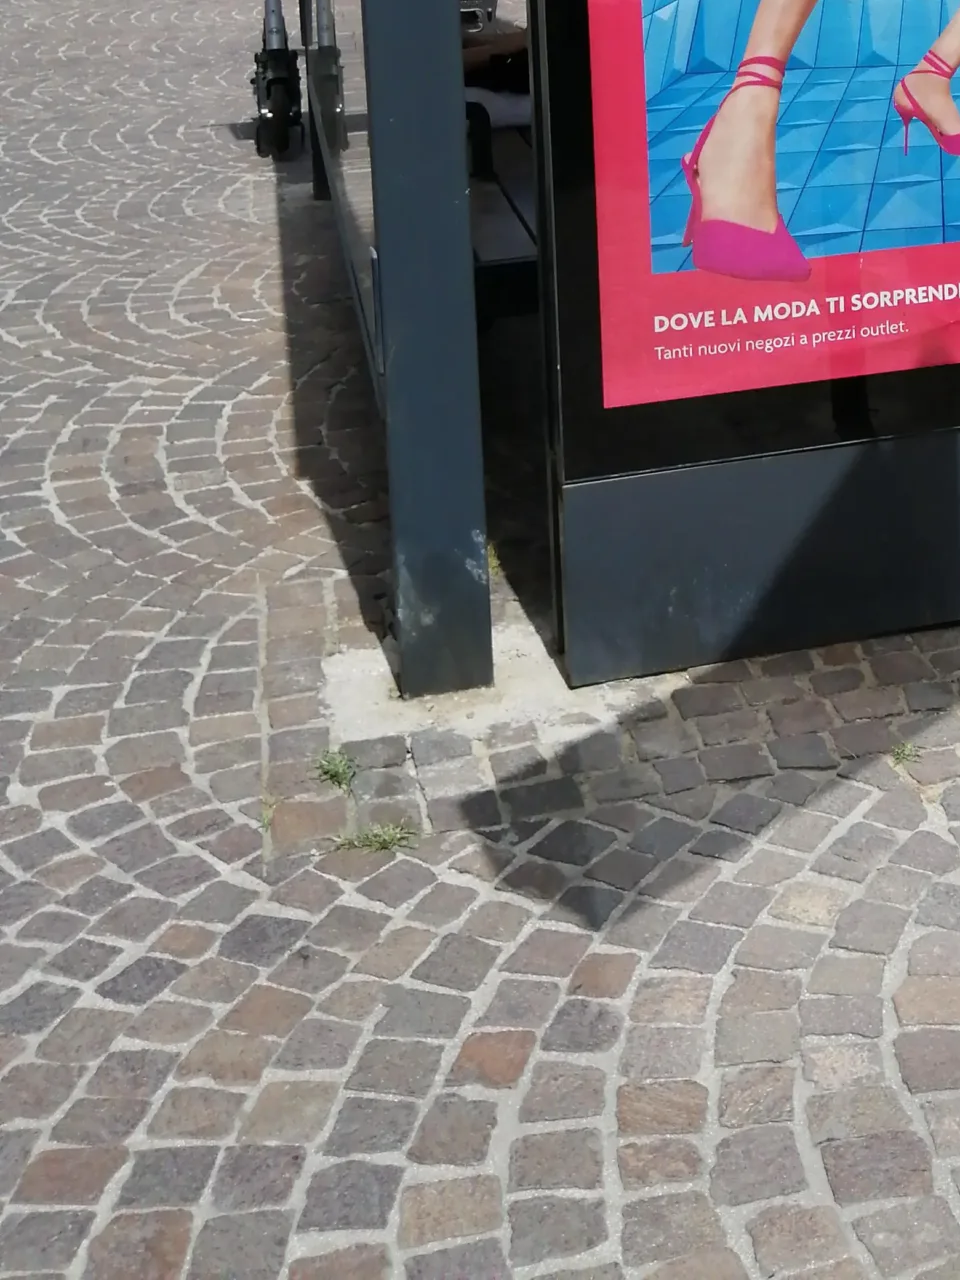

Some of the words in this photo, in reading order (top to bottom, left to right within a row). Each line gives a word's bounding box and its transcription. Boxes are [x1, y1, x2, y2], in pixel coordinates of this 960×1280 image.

[654, 310, 715, 333] DOVE
[721, 307, 748, 326] LA
[754, 299, 821, 323] MODA
[826, 296, 845, 314] TI
[654, 344, 693, 360] Tanti
[698, 339, 741, 356] nuovi
[746, 333, 795, 353] negozi
[799, 333, 808, 346] a
[812, 326, 856, 348] prezzi
[860, 320, 909, 338] outlet.
